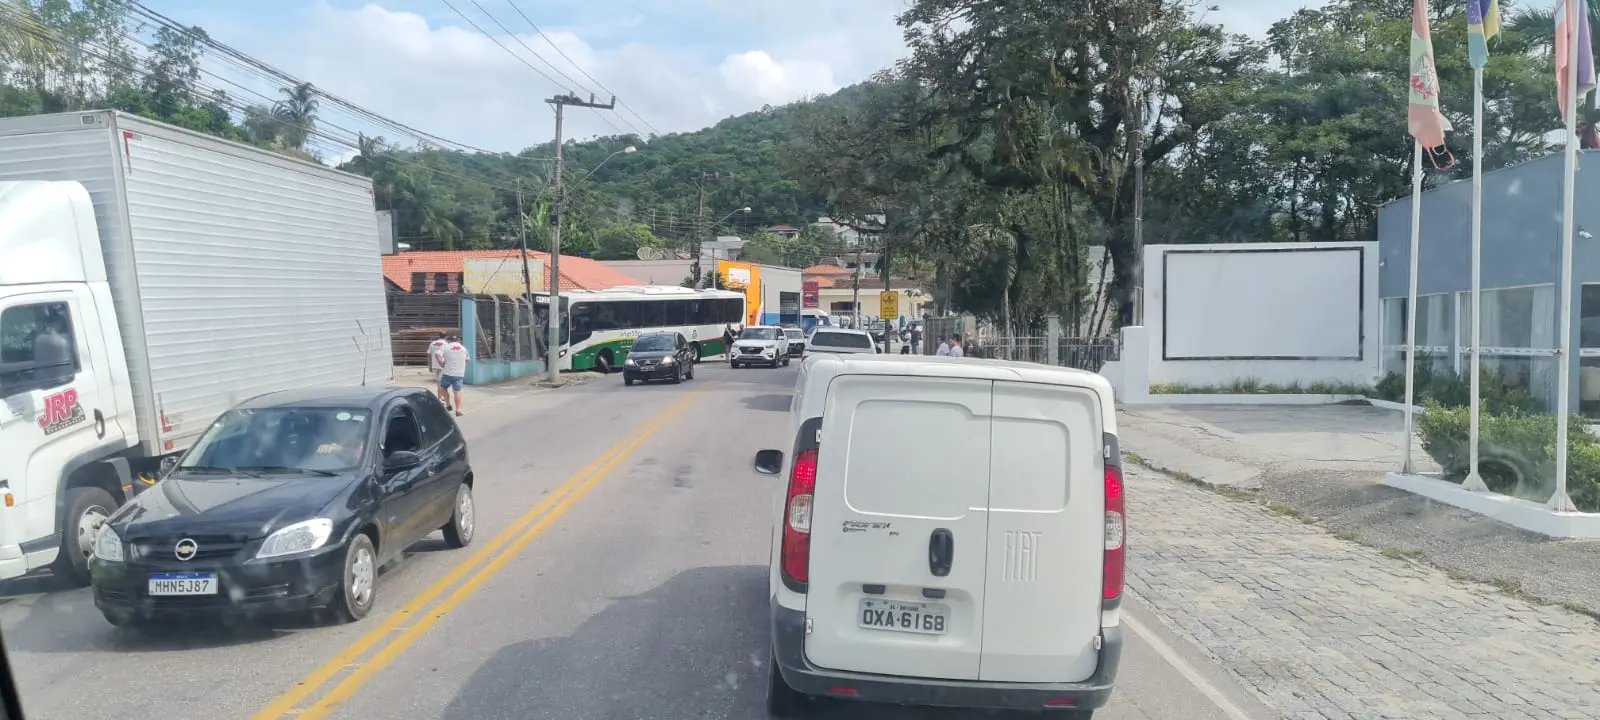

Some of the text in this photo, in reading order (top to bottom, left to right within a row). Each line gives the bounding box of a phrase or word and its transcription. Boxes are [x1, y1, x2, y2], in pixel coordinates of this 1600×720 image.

[38, 388, 79, 428] JRP
[1002, 530, 1043, 583] FIAT
[155, 580, 209, 593] MHN5J87
